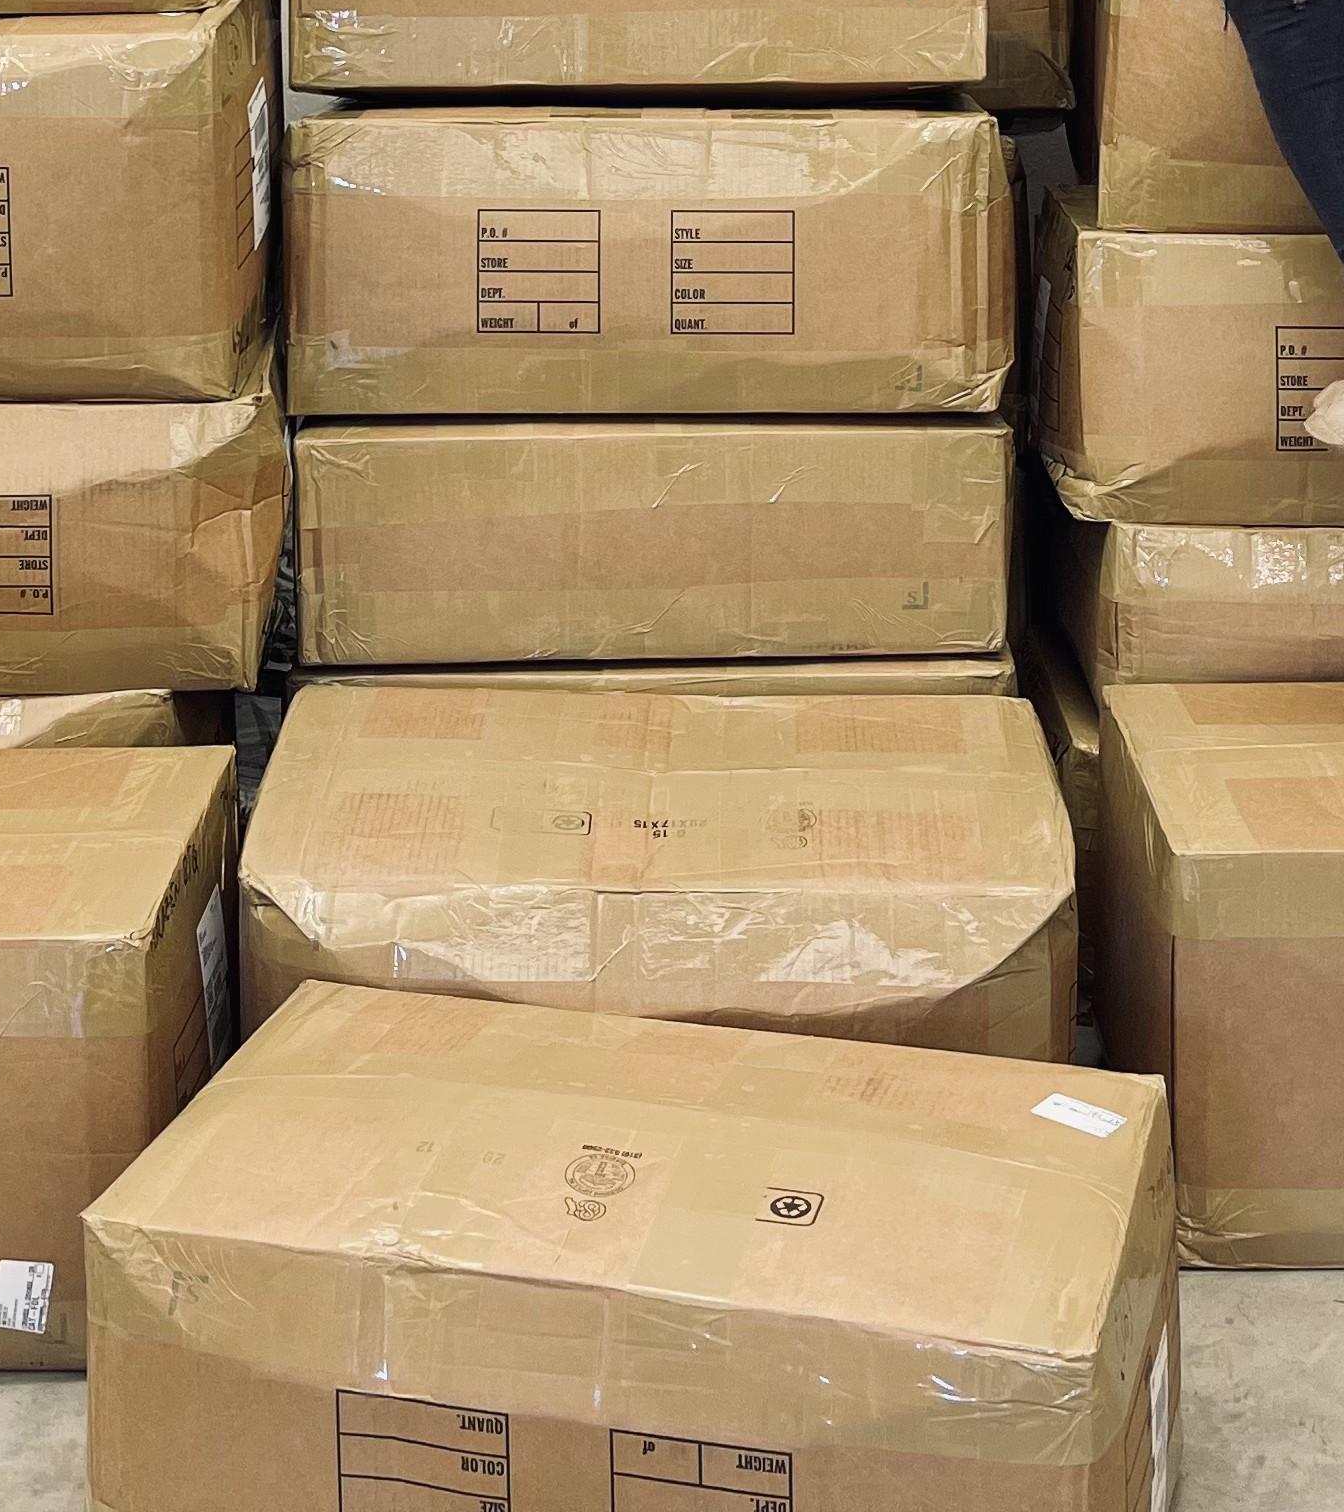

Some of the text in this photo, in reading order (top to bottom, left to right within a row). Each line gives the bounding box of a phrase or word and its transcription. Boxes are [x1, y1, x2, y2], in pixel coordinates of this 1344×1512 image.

[674, 228, 700, 239] STYLE
[480, 257, 509, 268] STORE
[674, 258, 693, 269] SIZE
[674, 288, 706, 300] COLOR
[480, 318, 514, 329] WEIGHT
[1280, 375, 1309, 387] STORE
[1280, 435, 1314, 447] WEIGHT
[11, 499, 48, 511] WEIGHT
[20, 529, 48, 541] DEPT.
[18, 559, 49, 570] STORE
[456, 1414, 503, 1434] QUANT.
[642, 1440, 655, 1455] of
[461, 1456, 505, 1477] COLOR
[736, 1453, 787, 1475] WEIGHT
